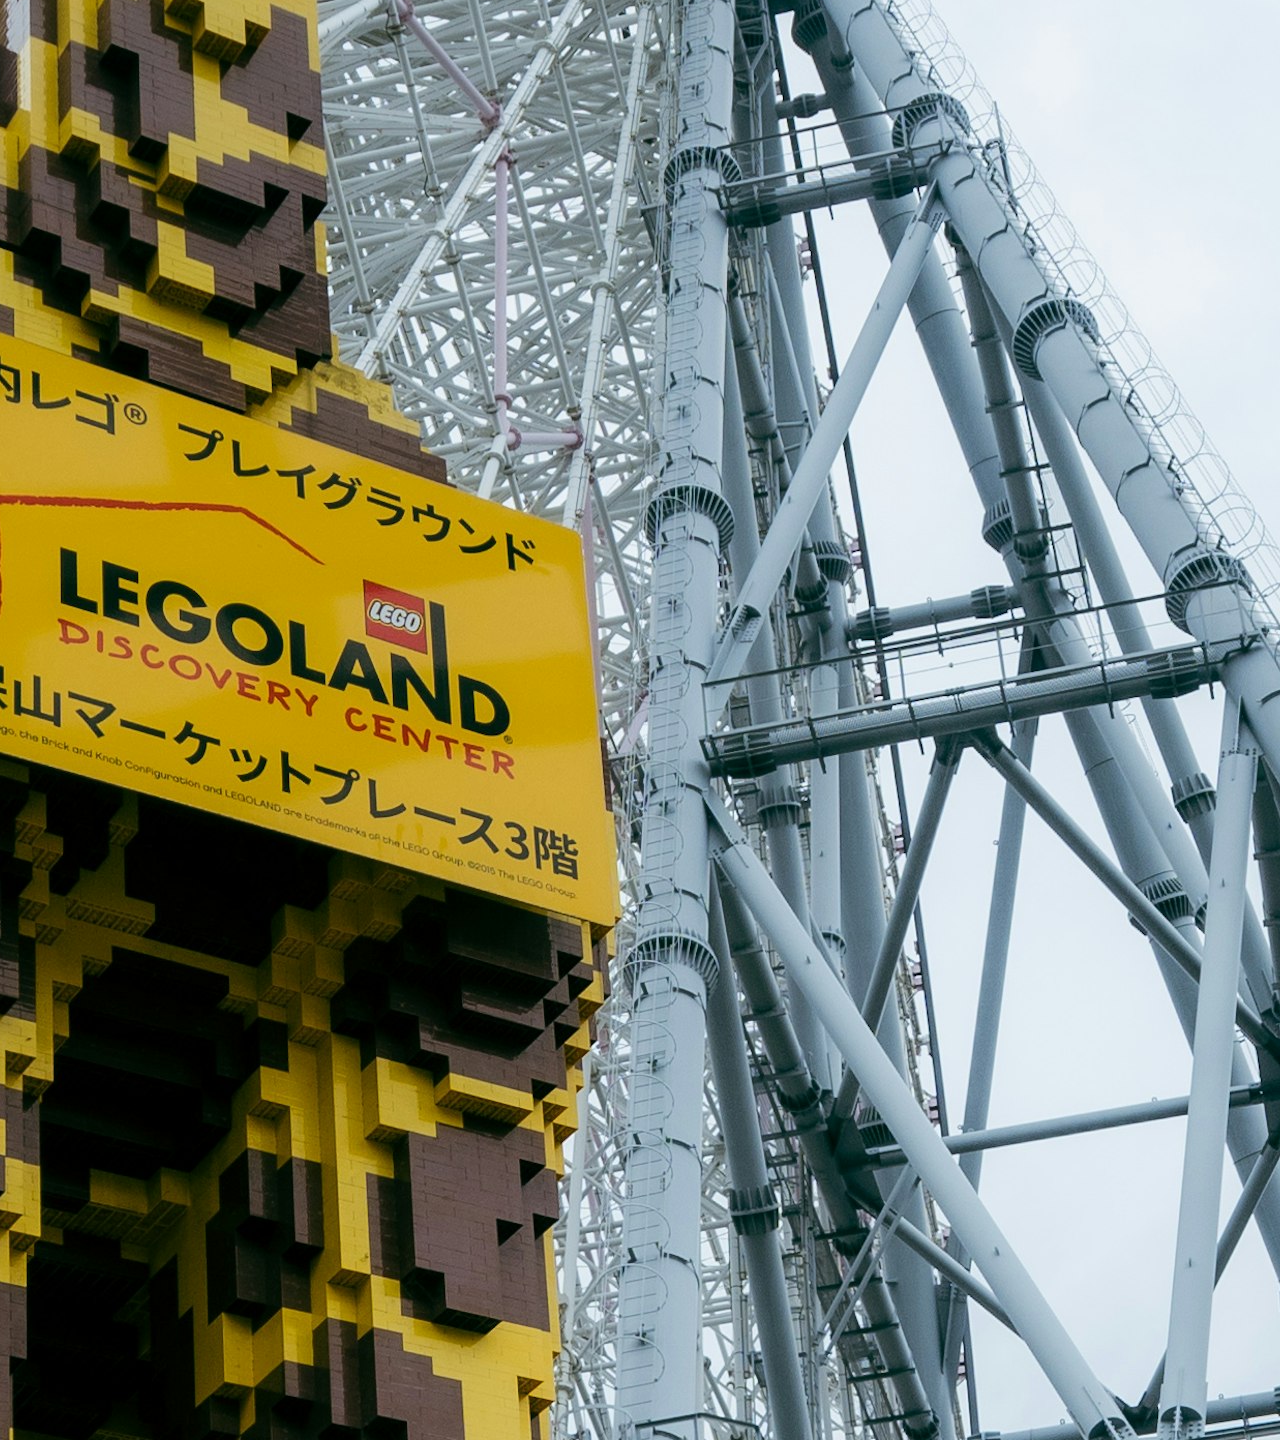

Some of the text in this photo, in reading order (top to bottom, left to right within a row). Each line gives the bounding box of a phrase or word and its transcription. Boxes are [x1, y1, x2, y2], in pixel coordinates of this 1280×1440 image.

[178, 423, 536, 571] プレイグラウンド
[369, 600, 423, 634] LEGO
[57, 618, 515, 780] DISCOVERY CENTER
[19, 730, 39, 742] the
[41, 735, 70, 752] Brick
[72, 745, 93, 758] and
[95, 752, 123, 766] Knob
[124, 760, 201, 789] Configuration
[203, 783, 222, 796] and
[225, 789, 282, 813] LEGOLAND
[283, 808, 302, 819] are
[304, 813, 367, 838] trademarks
[382, 835, 400, 847] the
[402, 842, 430, 856] LEGO
[498, 868, 515, 881] The
[517, 874, 543, 889] LEGO
